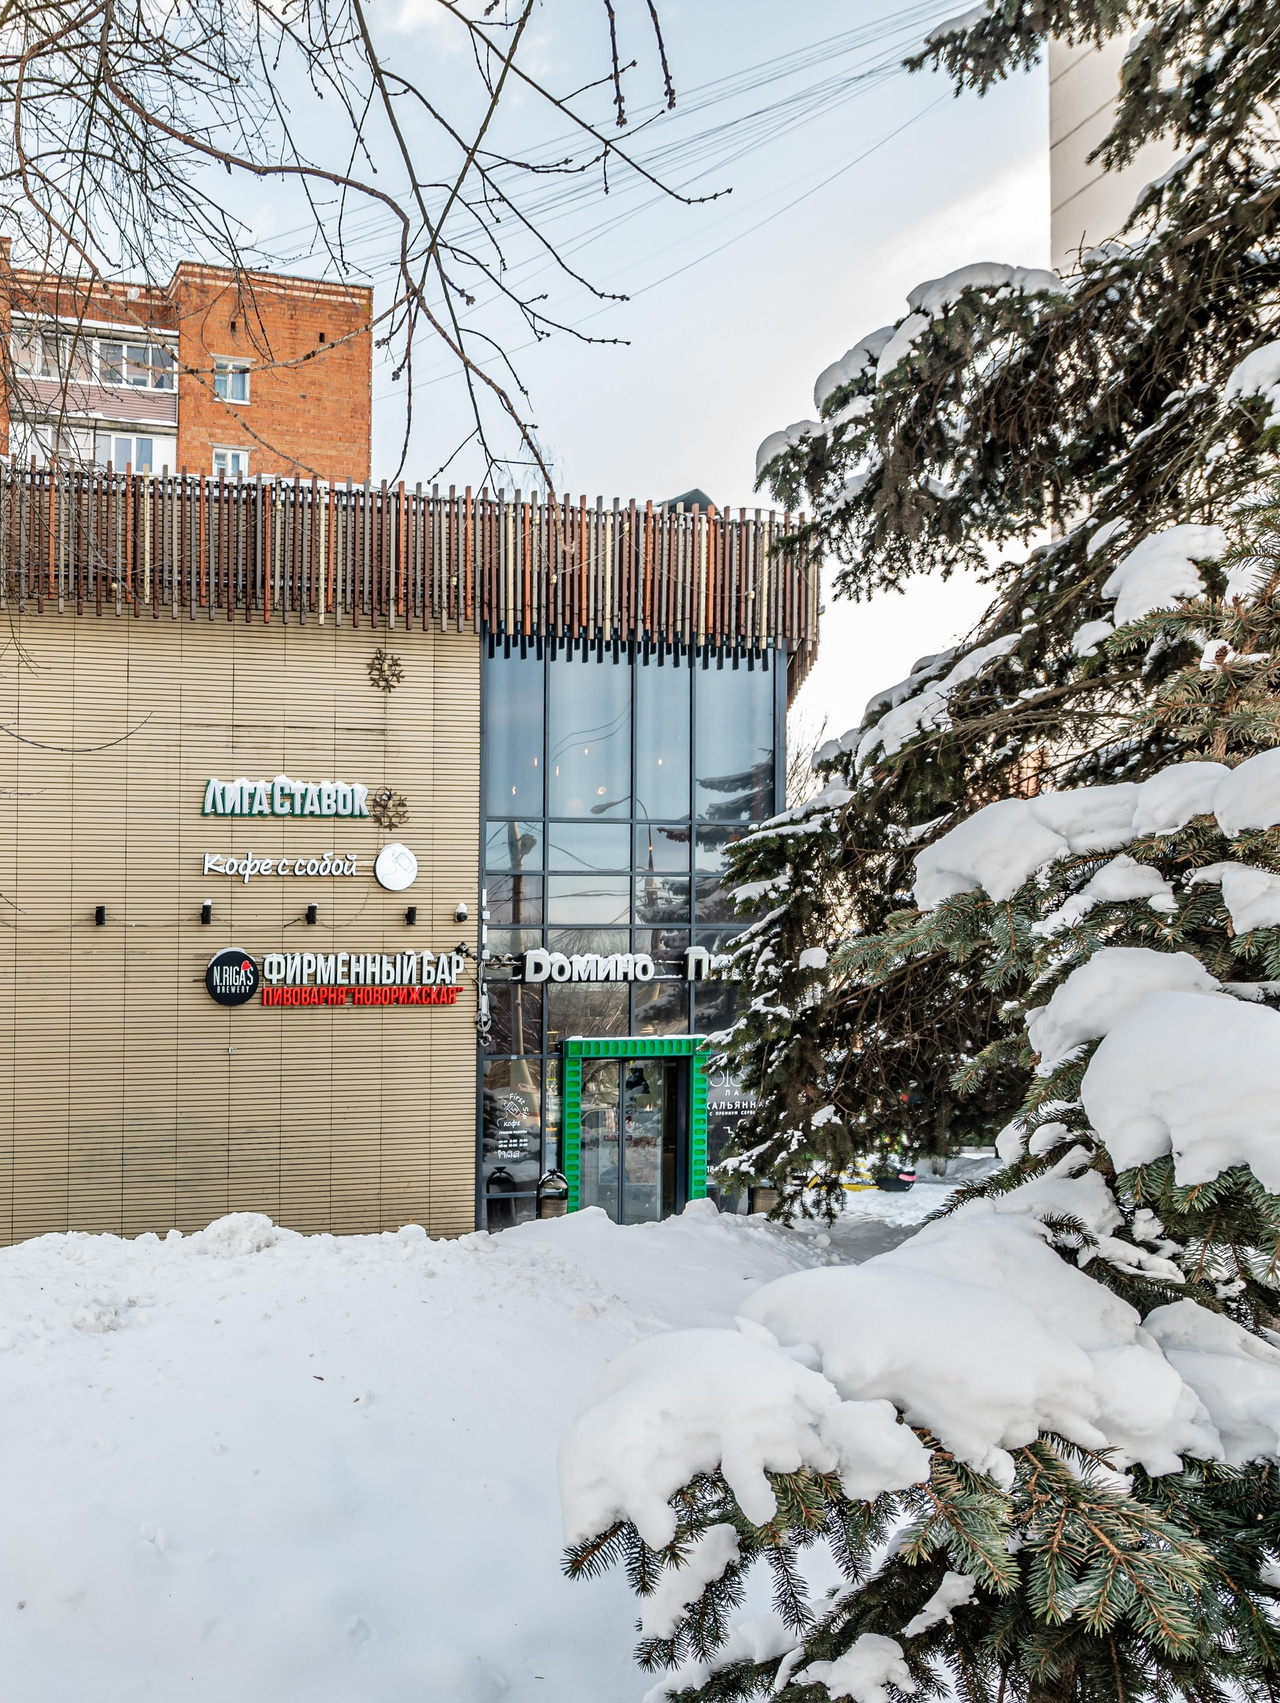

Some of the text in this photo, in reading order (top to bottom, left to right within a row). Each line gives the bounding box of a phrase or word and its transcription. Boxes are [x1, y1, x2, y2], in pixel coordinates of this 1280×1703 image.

[203, 851, 358, 884] Кофе с собой
[262, 953, 464, 984] ФИРМЕННЫЙ БАР
[216, 985, 250, 994] BREWERY
[262, 986, 348, 1006] ПИВОВАРНЯ
